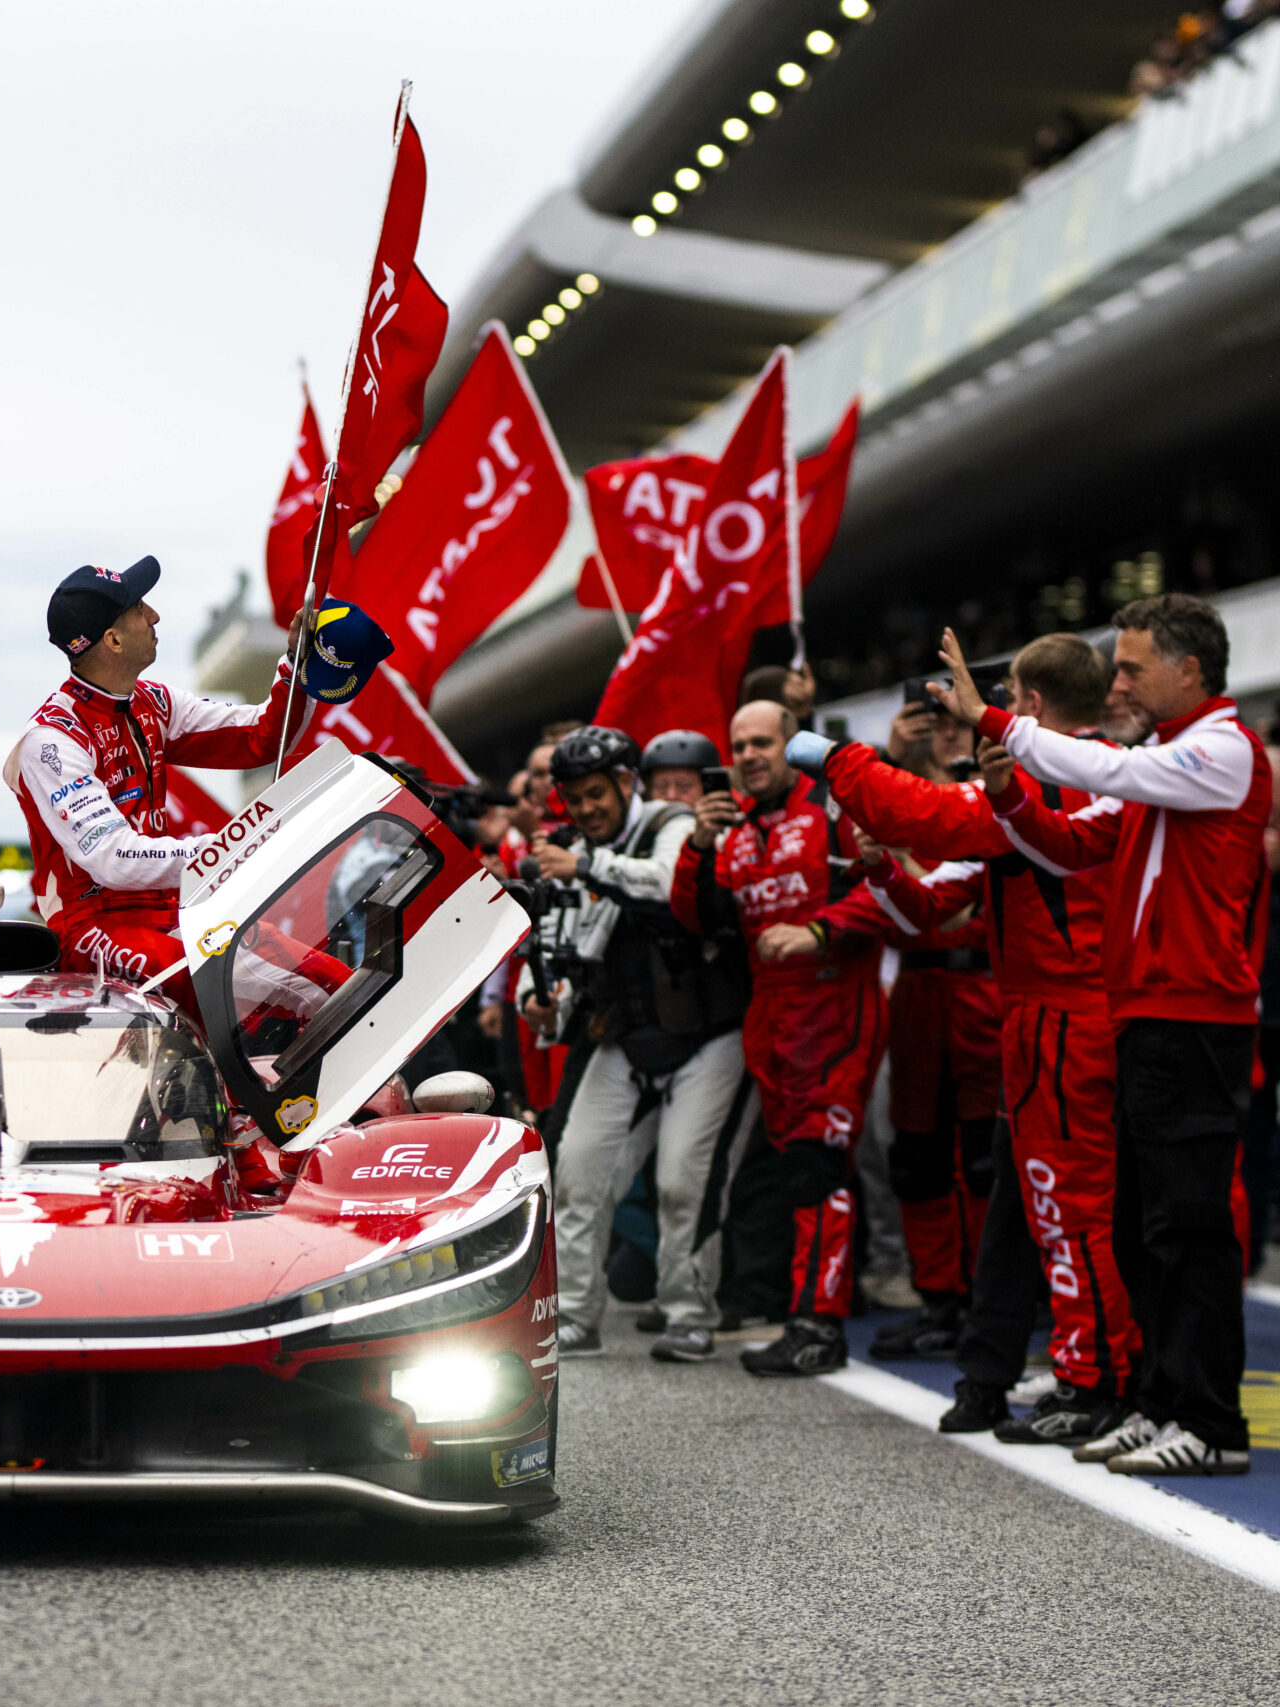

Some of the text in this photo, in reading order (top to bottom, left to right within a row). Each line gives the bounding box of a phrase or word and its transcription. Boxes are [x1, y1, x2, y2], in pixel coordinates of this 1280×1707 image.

[68, 795, 89, 810] JAPAN
[72, 795, 103, 813] AIRLINES
[186, 801, 274, 878] TOYOTA
[116, 848, 166, 859] RICHARD
[74, 926, 148, 982] DENSO
[351, 1165, 454, 1180] EDIFICE
[1026, 1158, 1080, 1299] DENSO
[143, 1233, 222, 1256] HY
